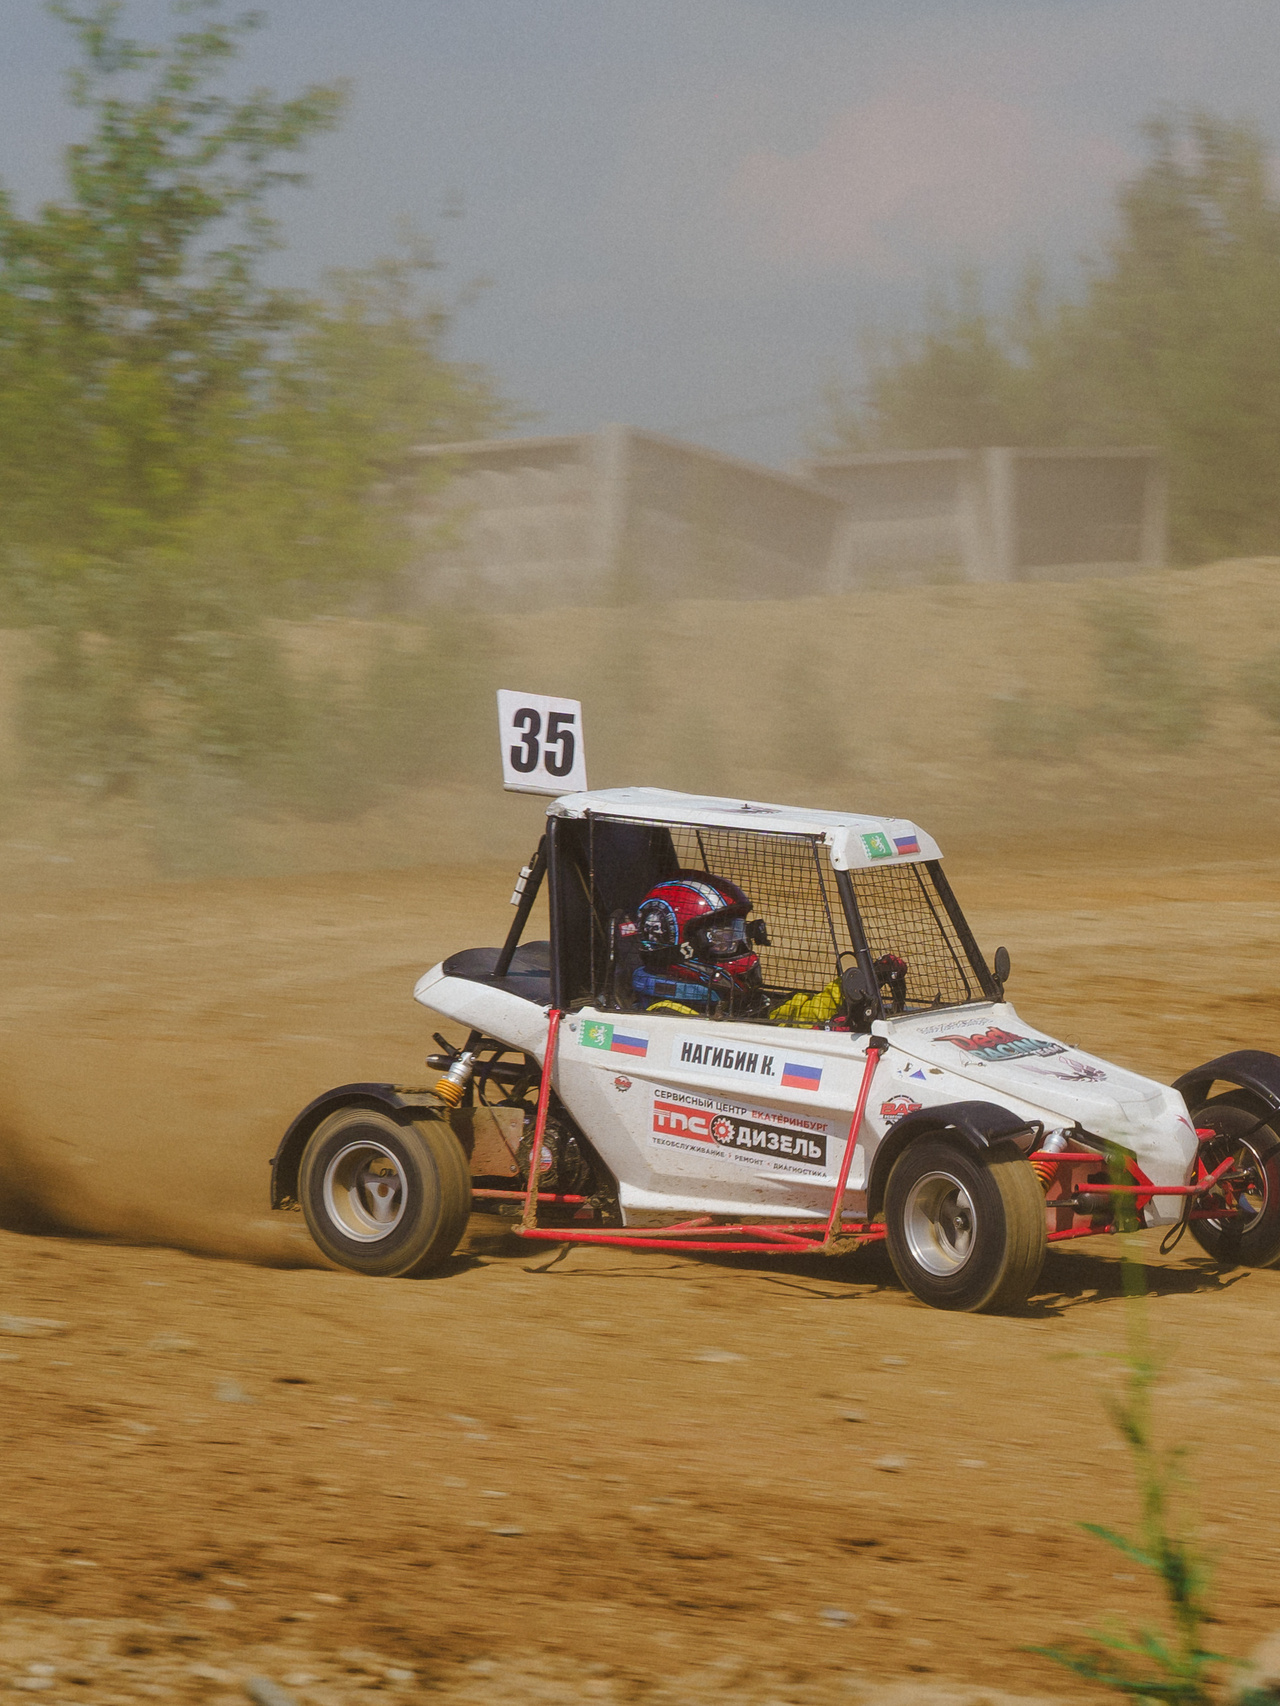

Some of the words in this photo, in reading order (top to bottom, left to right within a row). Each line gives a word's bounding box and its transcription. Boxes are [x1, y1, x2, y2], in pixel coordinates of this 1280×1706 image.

[510, 708, 575, 777] 35
[680, 1042, 759, 1073] НАГИБИН
[760, 1055, 775, 1076] К.
[654, 1089, 713, 1109] СЕРВИСНЫЙ
[715, 1101, 747, 1115] ЦЕНТР
[751, 1109, 828, 1131] ЕКАТЕРИНБУРГ
[652, 1136, 725, 1158] ТЕХОБСЛУЖИВАНИЕ
[734, 1154, 763, 1166] РЕМОНТ
[736, 1126, 822, 1159] ДИЗЕЛЬ
